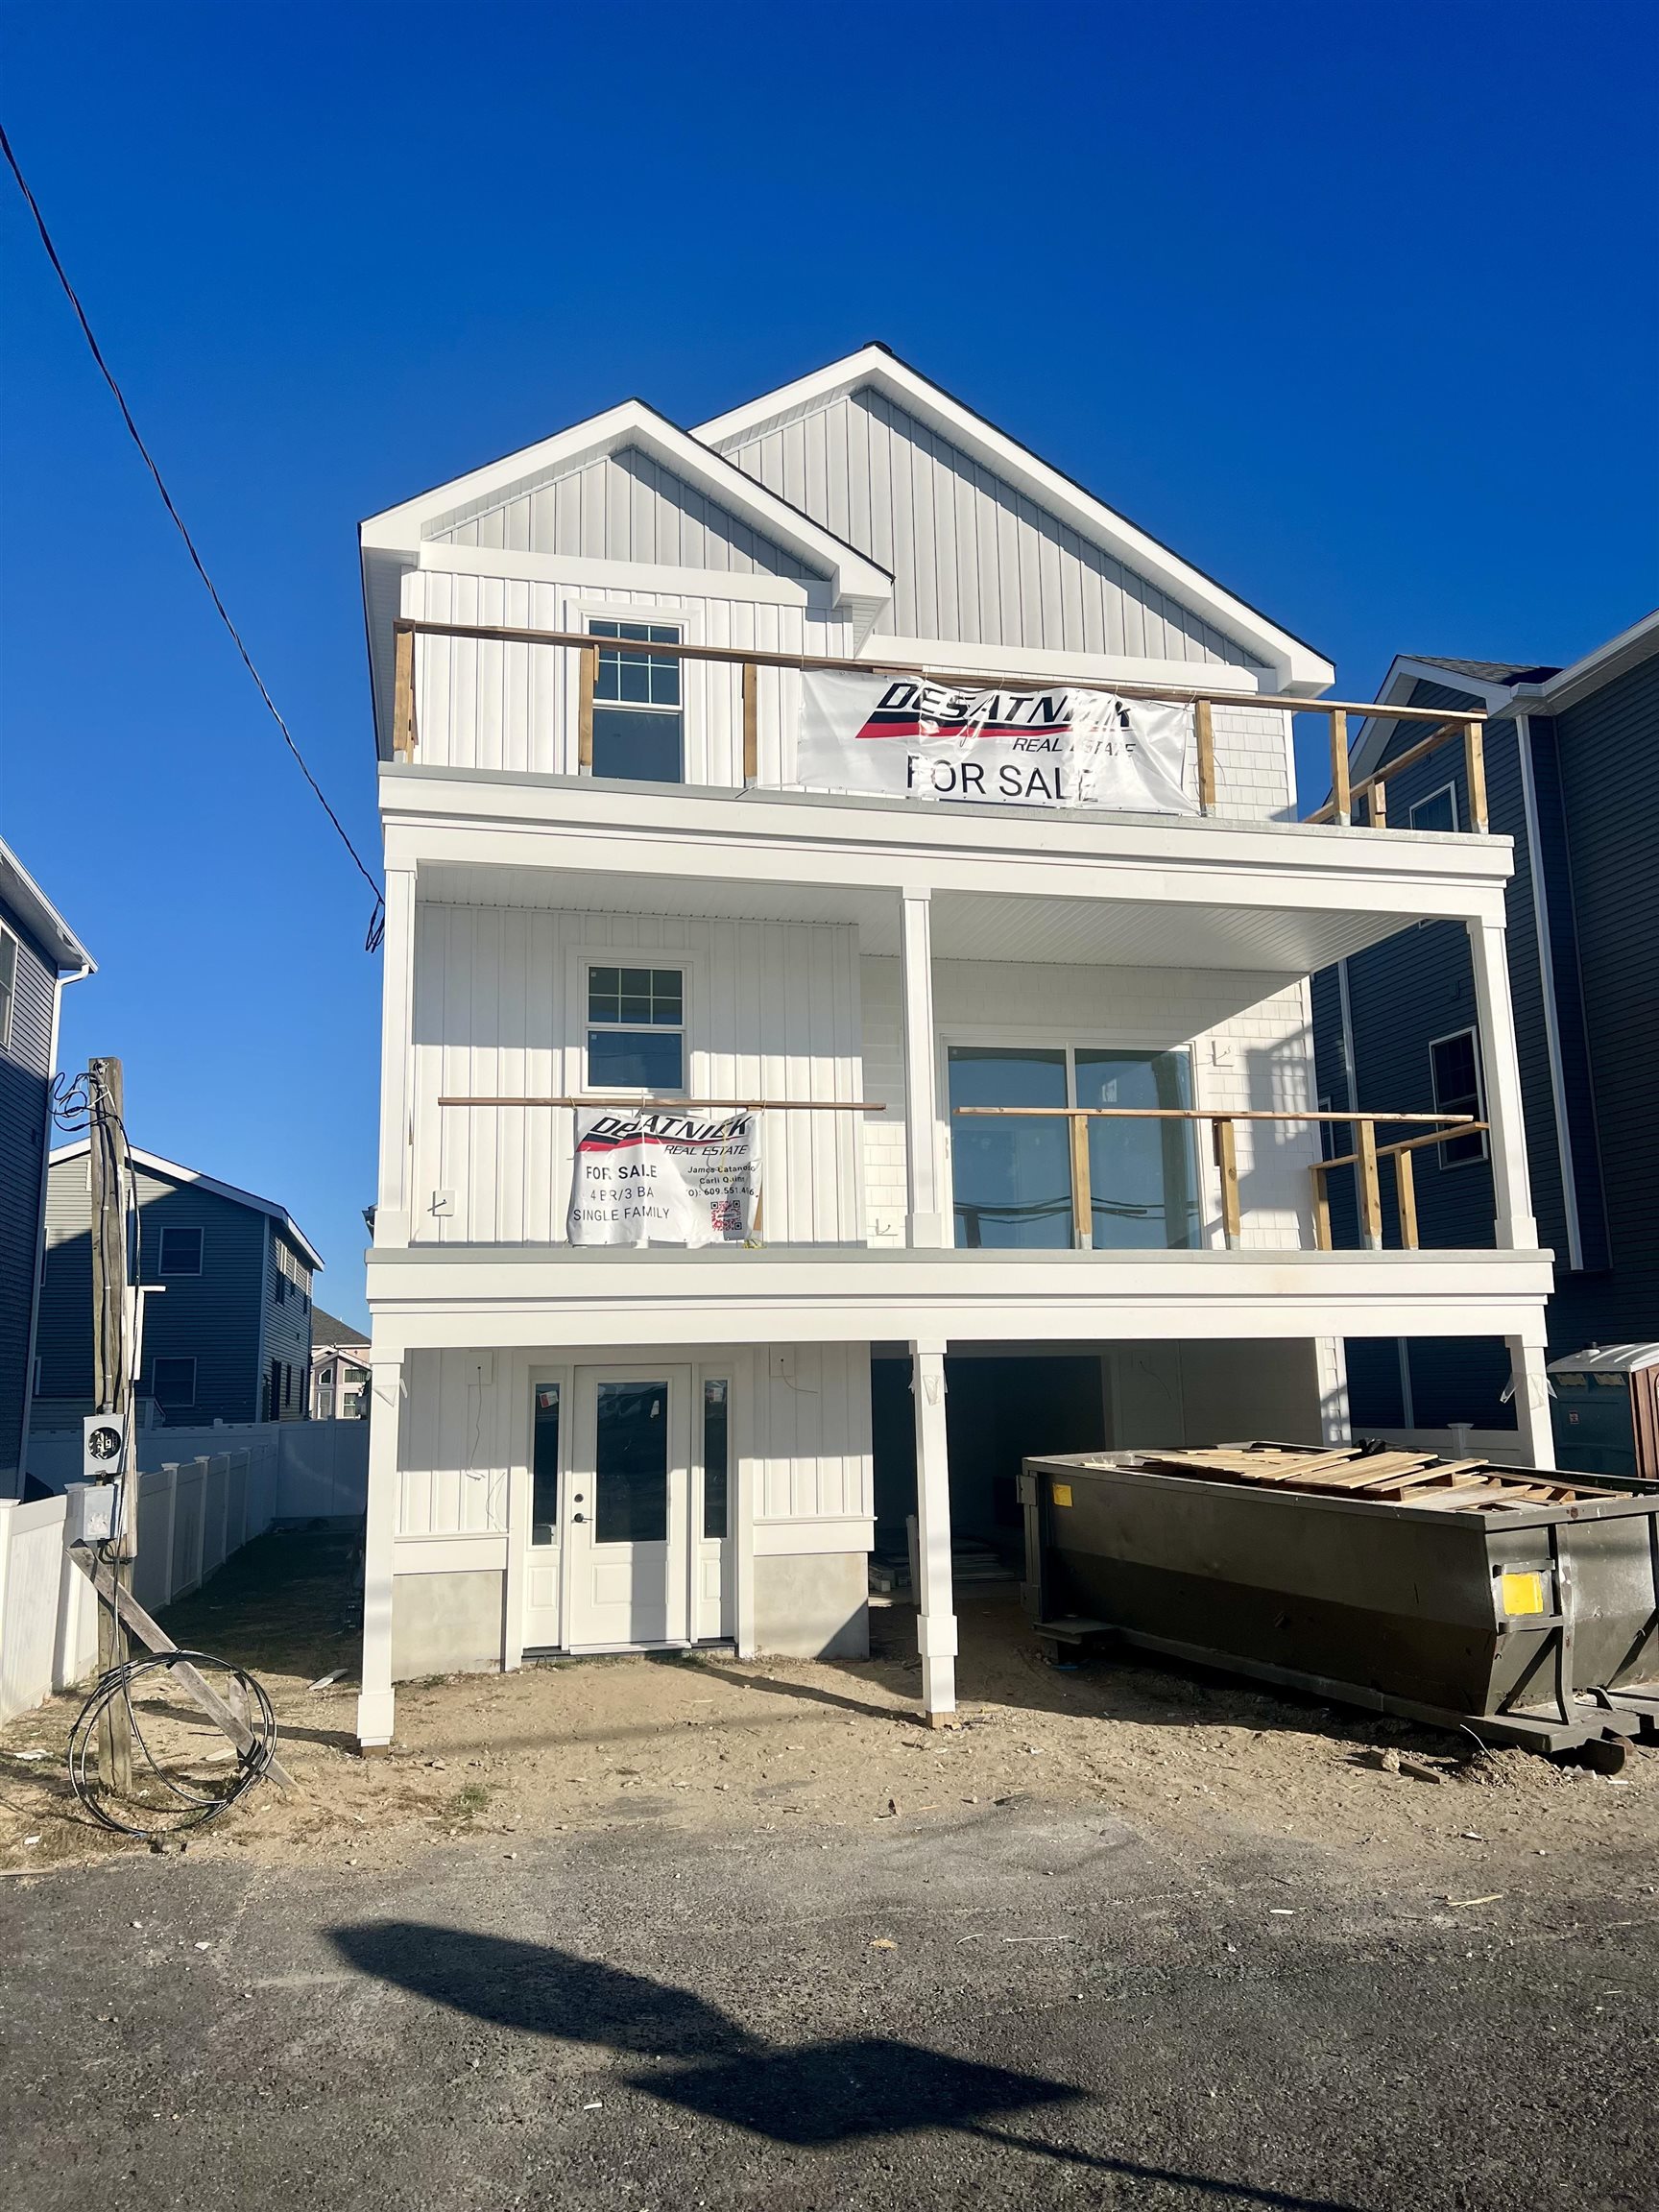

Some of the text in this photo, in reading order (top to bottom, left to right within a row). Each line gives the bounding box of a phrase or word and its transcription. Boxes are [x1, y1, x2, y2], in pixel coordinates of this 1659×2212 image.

[877, 683, 1131, 728] DESATNIK
[1013, 737, 1137, 757] REAL STAE
[907, 755, 1099, 803] FOR SALE
[589, 1115, 753, 1140] DEATNICK
[664, 1144, 749, 1156] REAL ESTATE
[586, 1164, 658, 1180] FOR SALE
[687, 1166, 715, 1174] James
[699, 1176, 720, 1185] Carli
[590, 1190, 597, 1201] 4
[637, 1186, 655, 1198] BA
[573, 1205, 670, 1222] SINGLE FAMILY
